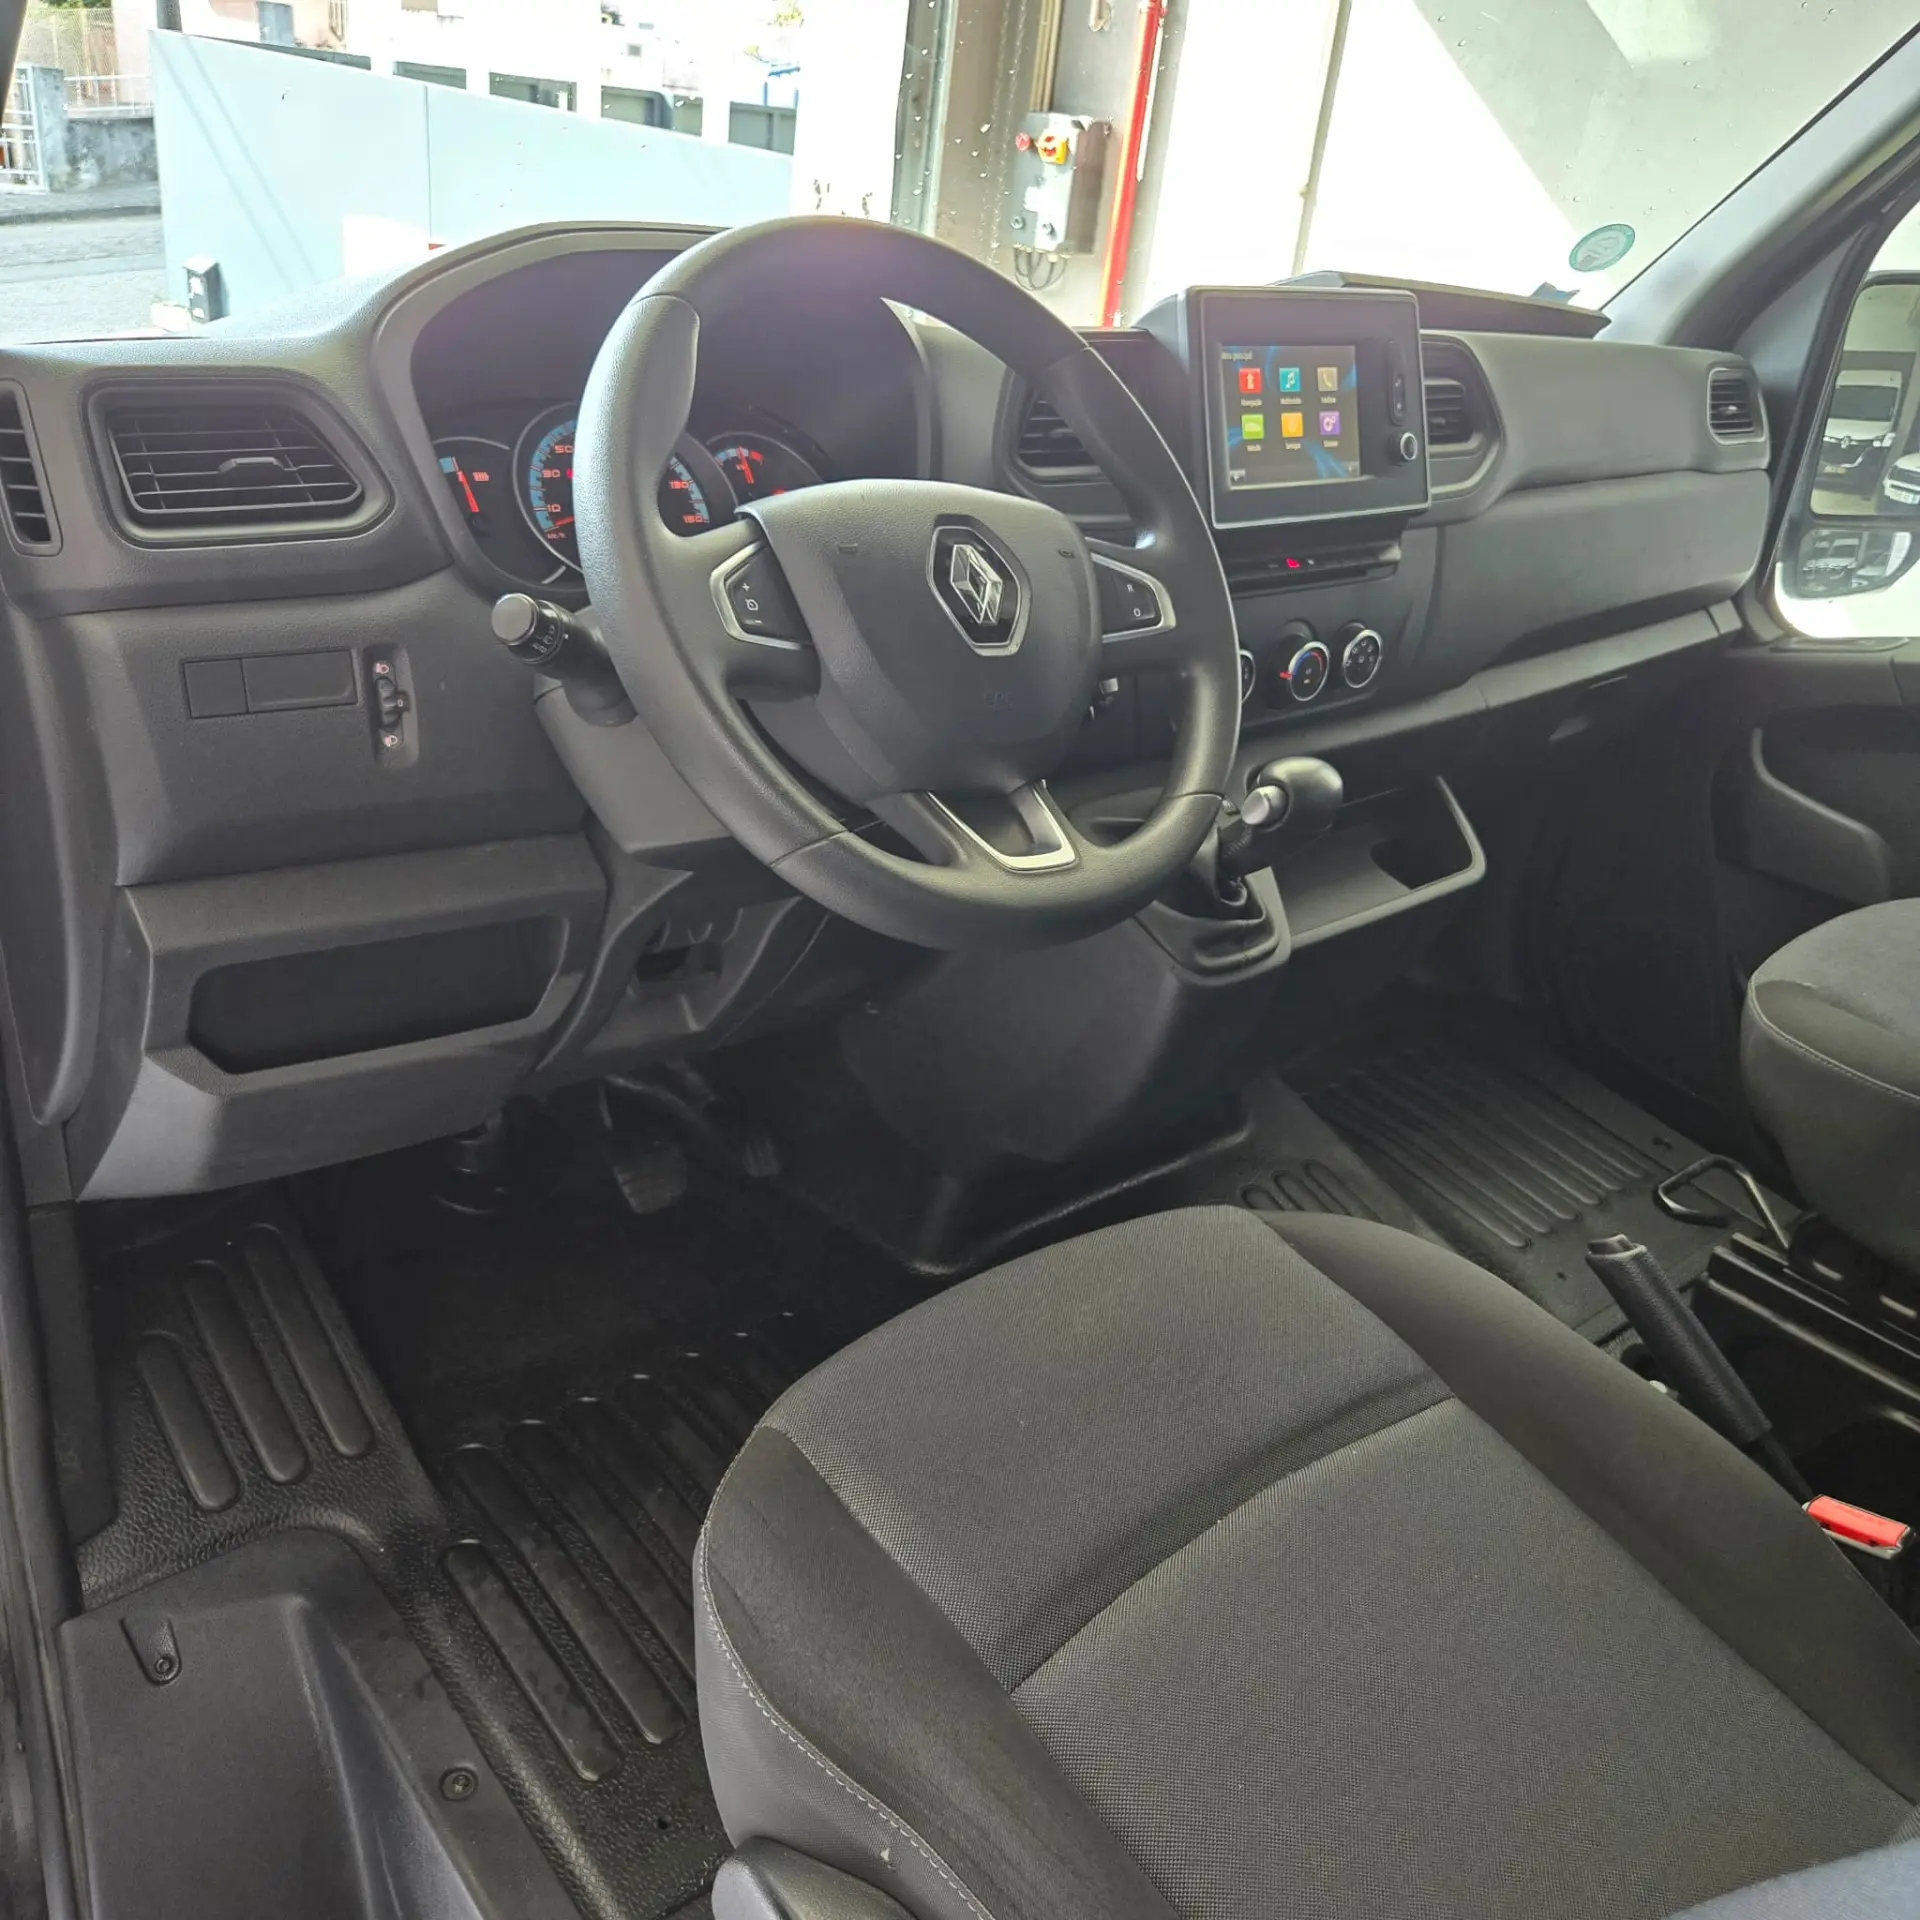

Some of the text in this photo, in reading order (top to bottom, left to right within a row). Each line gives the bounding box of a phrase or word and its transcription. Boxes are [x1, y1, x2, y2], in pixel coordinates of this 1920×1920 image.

[554, 444, 574, 454] 50
[547, 503, 561, 513] 10
[682, 514, 704, 524] 150
[1126, 583, 1135, 593] R
